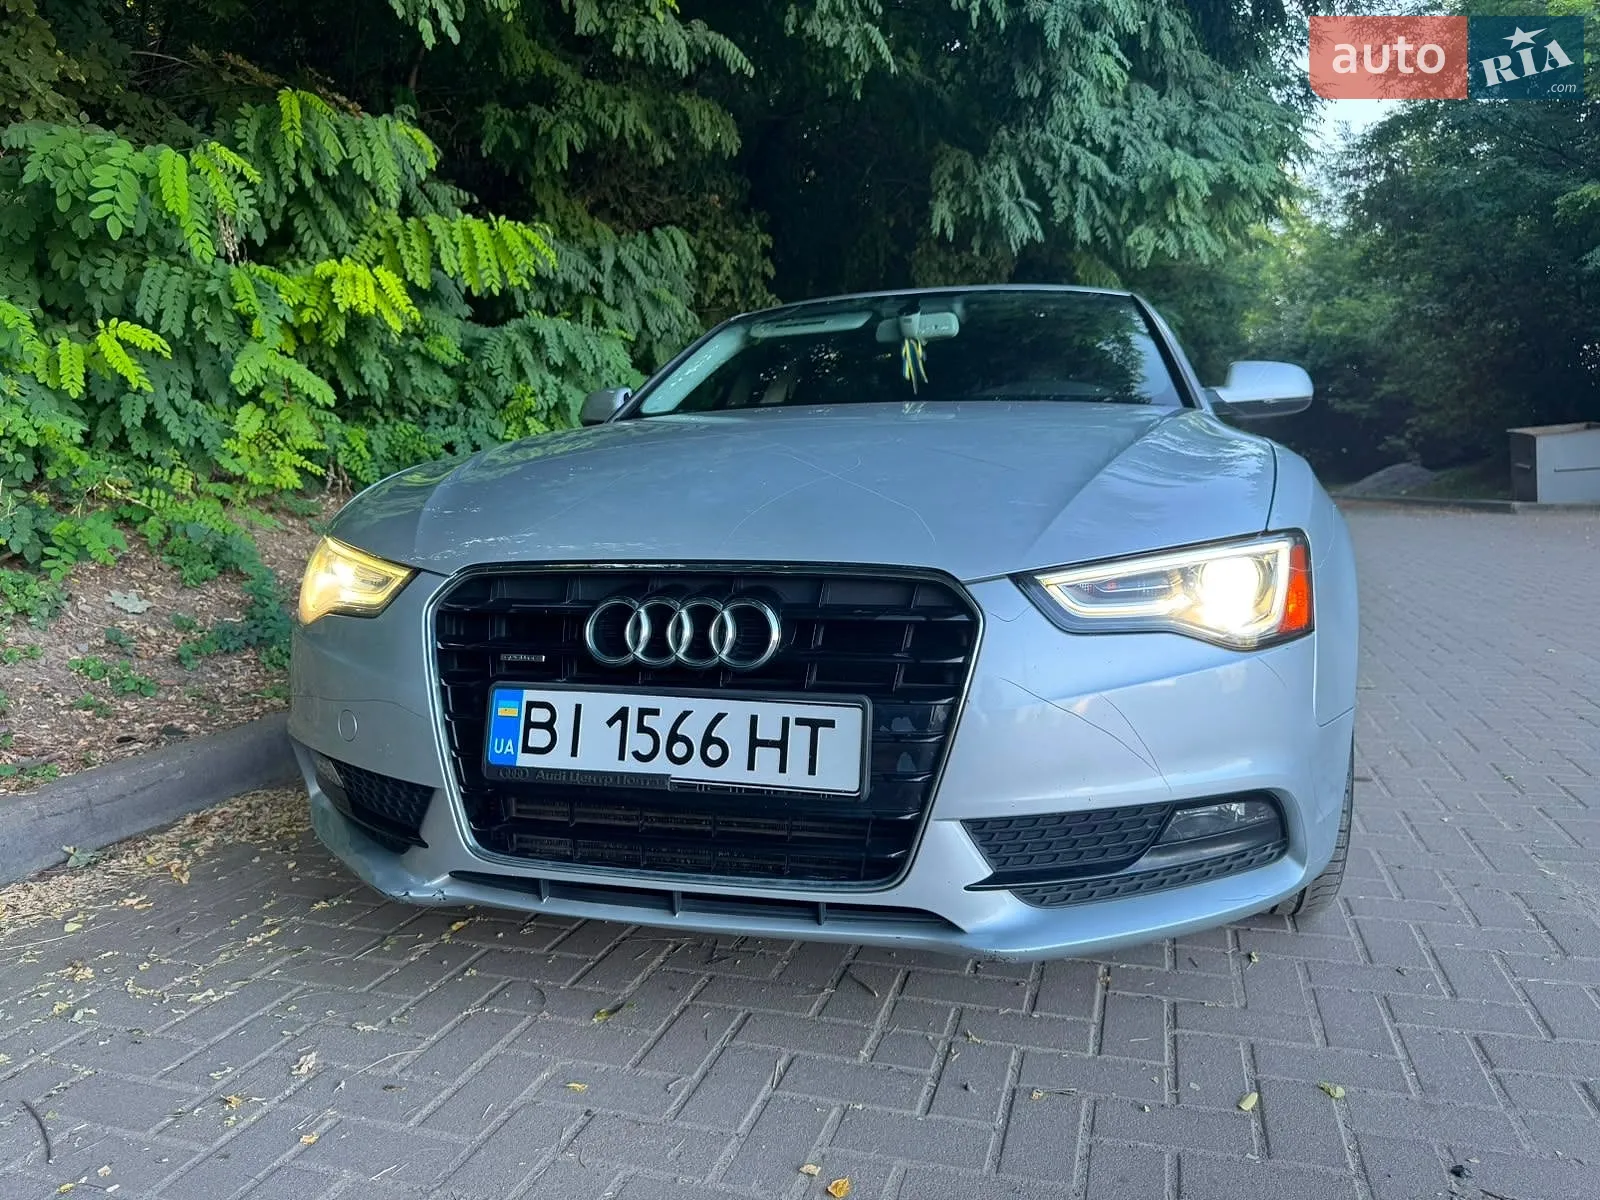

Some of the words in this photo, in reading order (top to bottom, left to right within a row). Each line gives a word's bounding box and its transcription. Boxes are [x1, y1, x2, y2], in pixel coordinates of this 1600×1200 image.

[494, 737, 515, 756] UA
[521, 700, 583, 758] BI
[605, 706, 730, 769] 1566
[747, 714, 836, 776] HT
[535, 769, 566, 782] Audi
